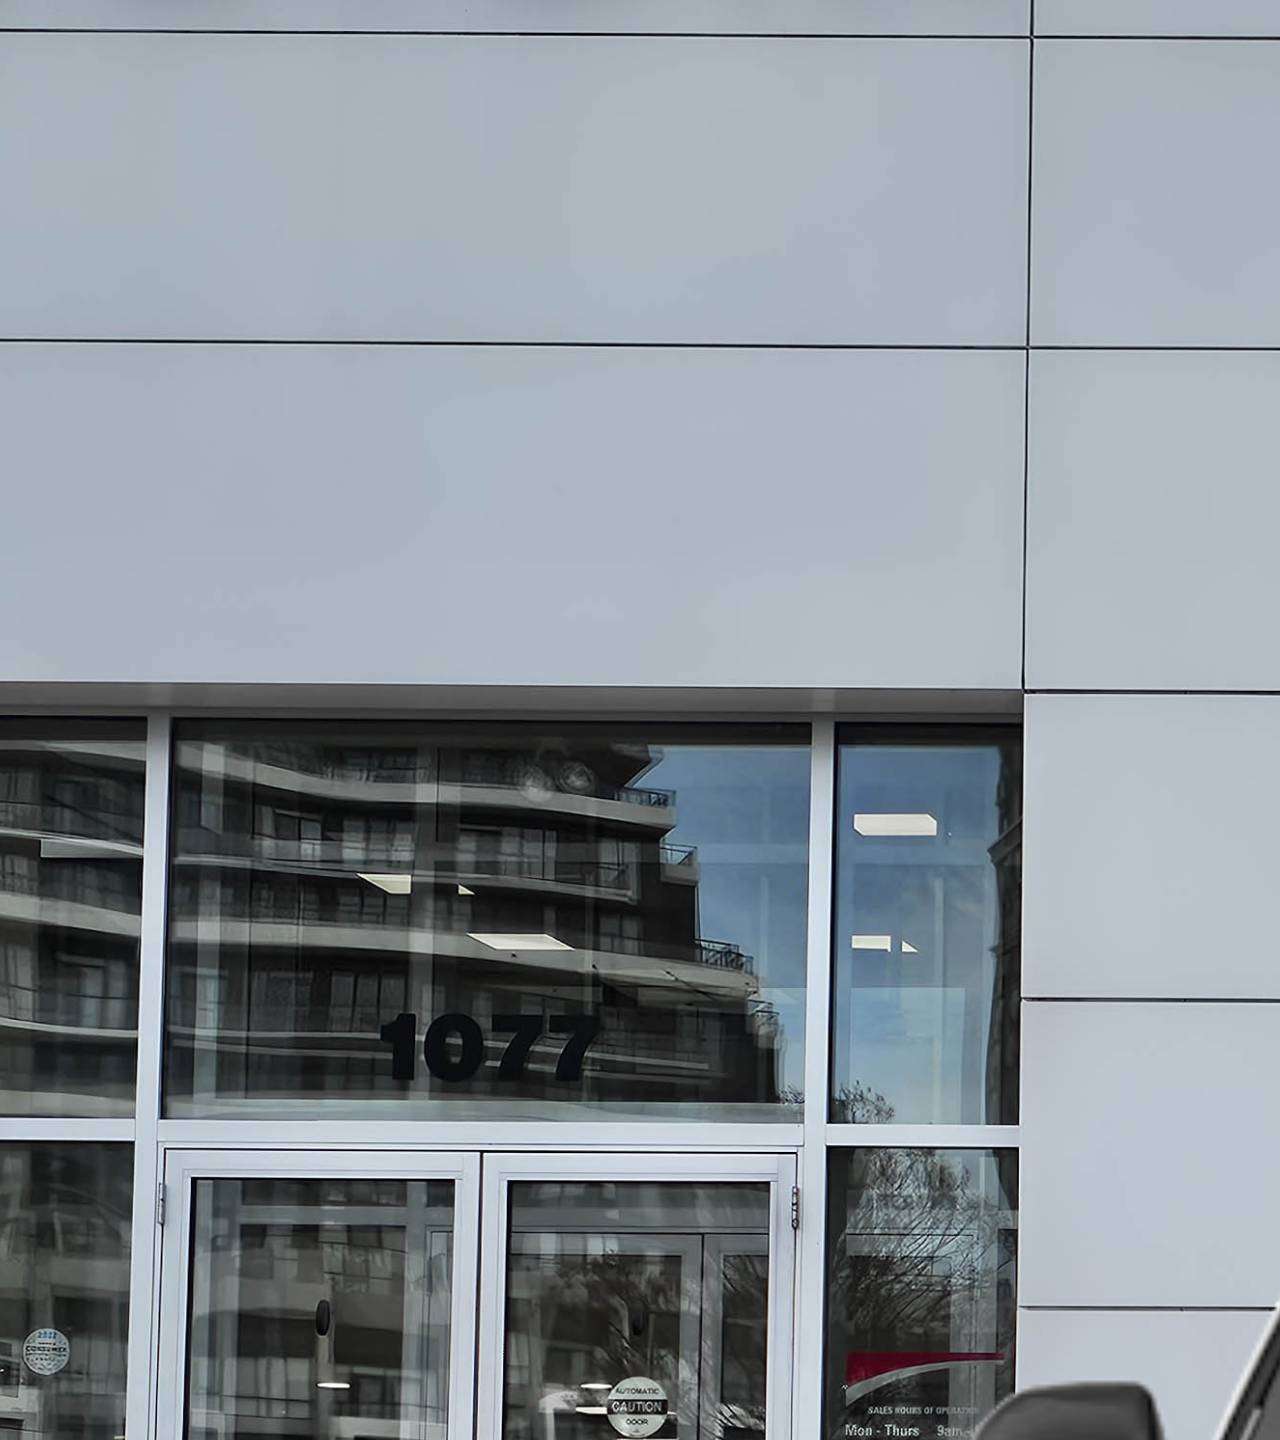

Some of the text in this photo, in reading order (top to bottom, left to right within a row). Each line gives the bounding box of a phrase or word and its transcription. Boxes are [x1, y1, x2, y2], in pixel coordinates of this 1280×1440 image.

[380, 1013, 597, 1082] 1077
[615, 1387, 660, 1395] AUTOMATIC
[611, 1401, 662, 1413] CAUTION
[867, 1406, 893, 1415] SALES
[626, 1418, 649, 1426] DOOR
[845, 1424, 873, 1437] Mon
[885, 1424, 920, 1437] Thurs
